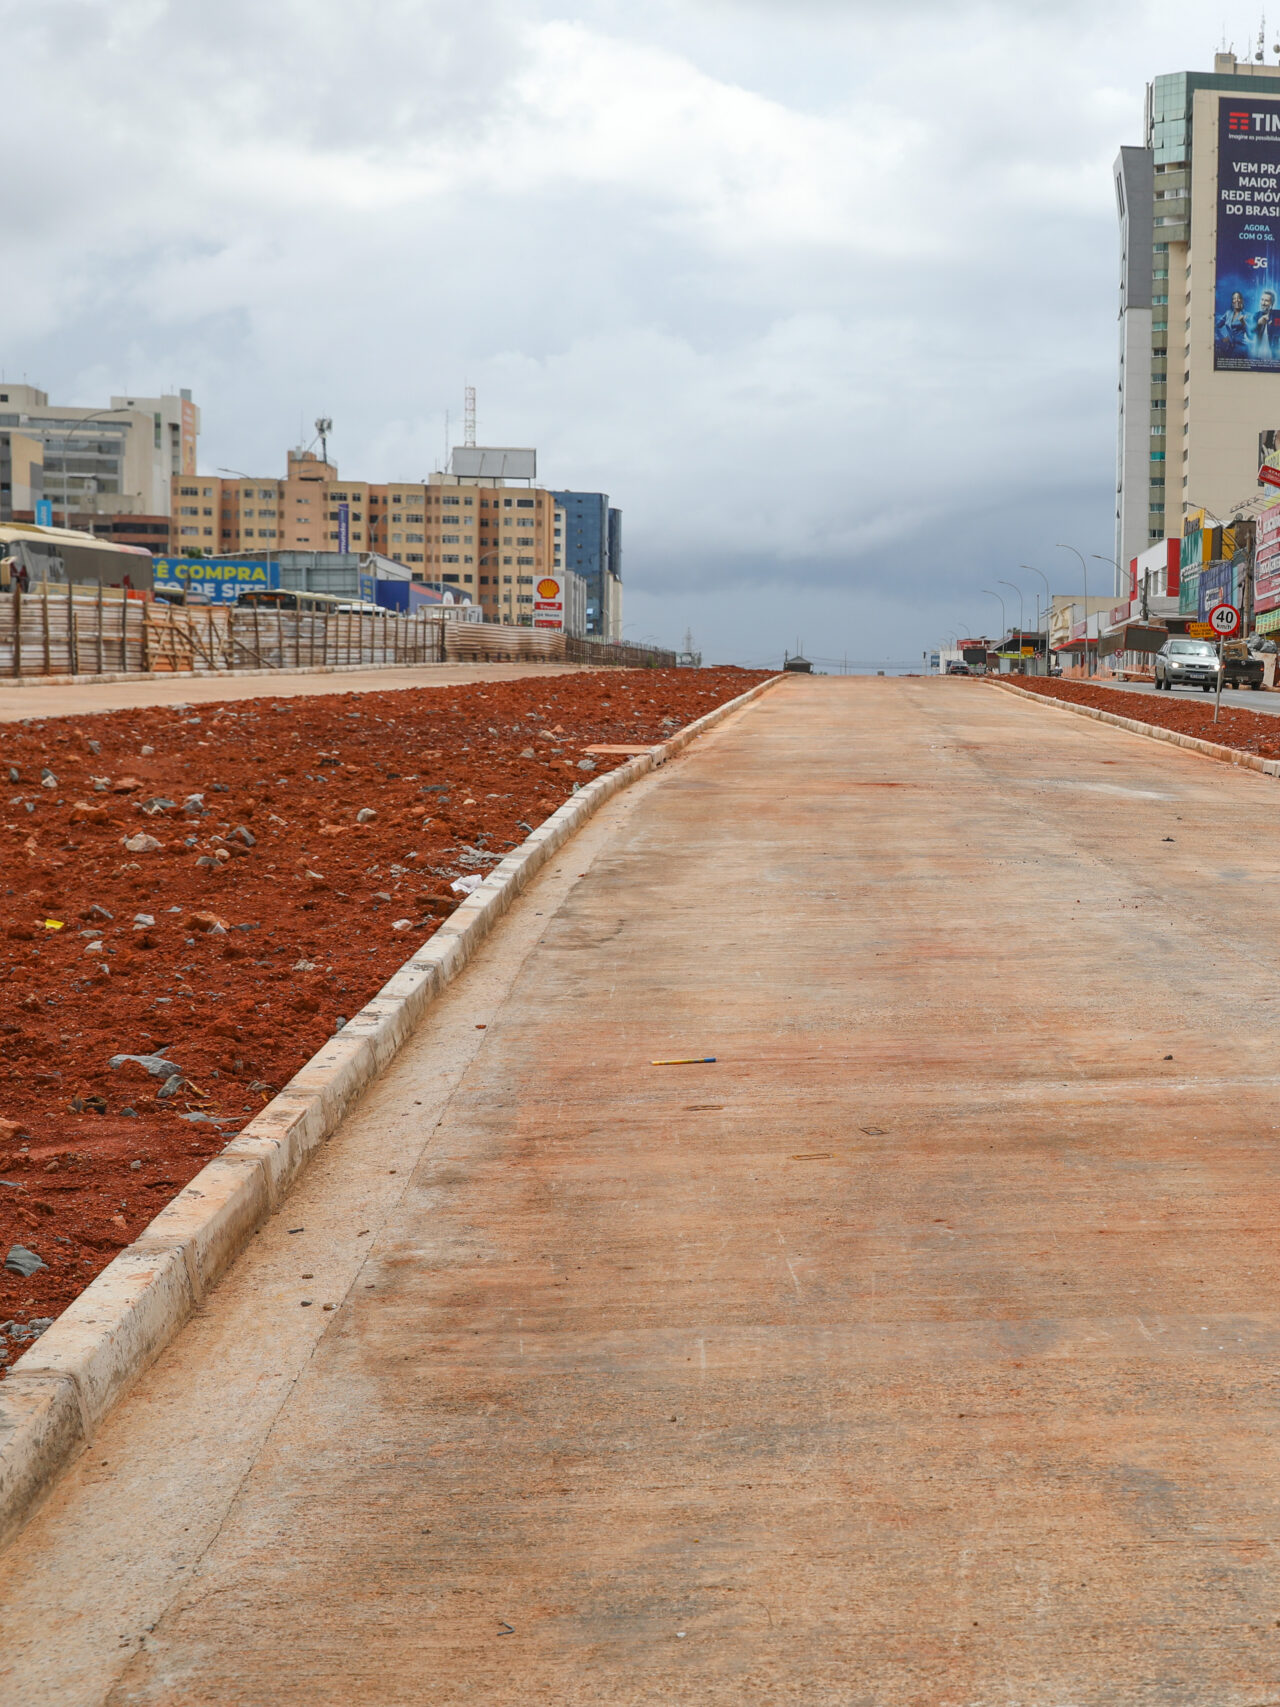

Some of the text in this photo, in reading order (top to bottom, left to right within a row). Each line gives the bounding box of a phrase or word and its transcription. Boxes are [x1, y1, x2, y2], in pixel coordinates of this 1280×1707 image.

[1232, 162, 1258, 173] VEM
[1238, 177, 1277, 188] MAIOR
[1221, 190, 1252, 201] REDE
[1225, 204, 1243, 215] DO
[1239, 232, 1255, 240] COM
[1252, 256, 1268, 268] 5G
[174, 565, 267, 581] COMPRA
[1216, 610, 1234, 624] 40
[1216, 623, 1232, 631] km/h
